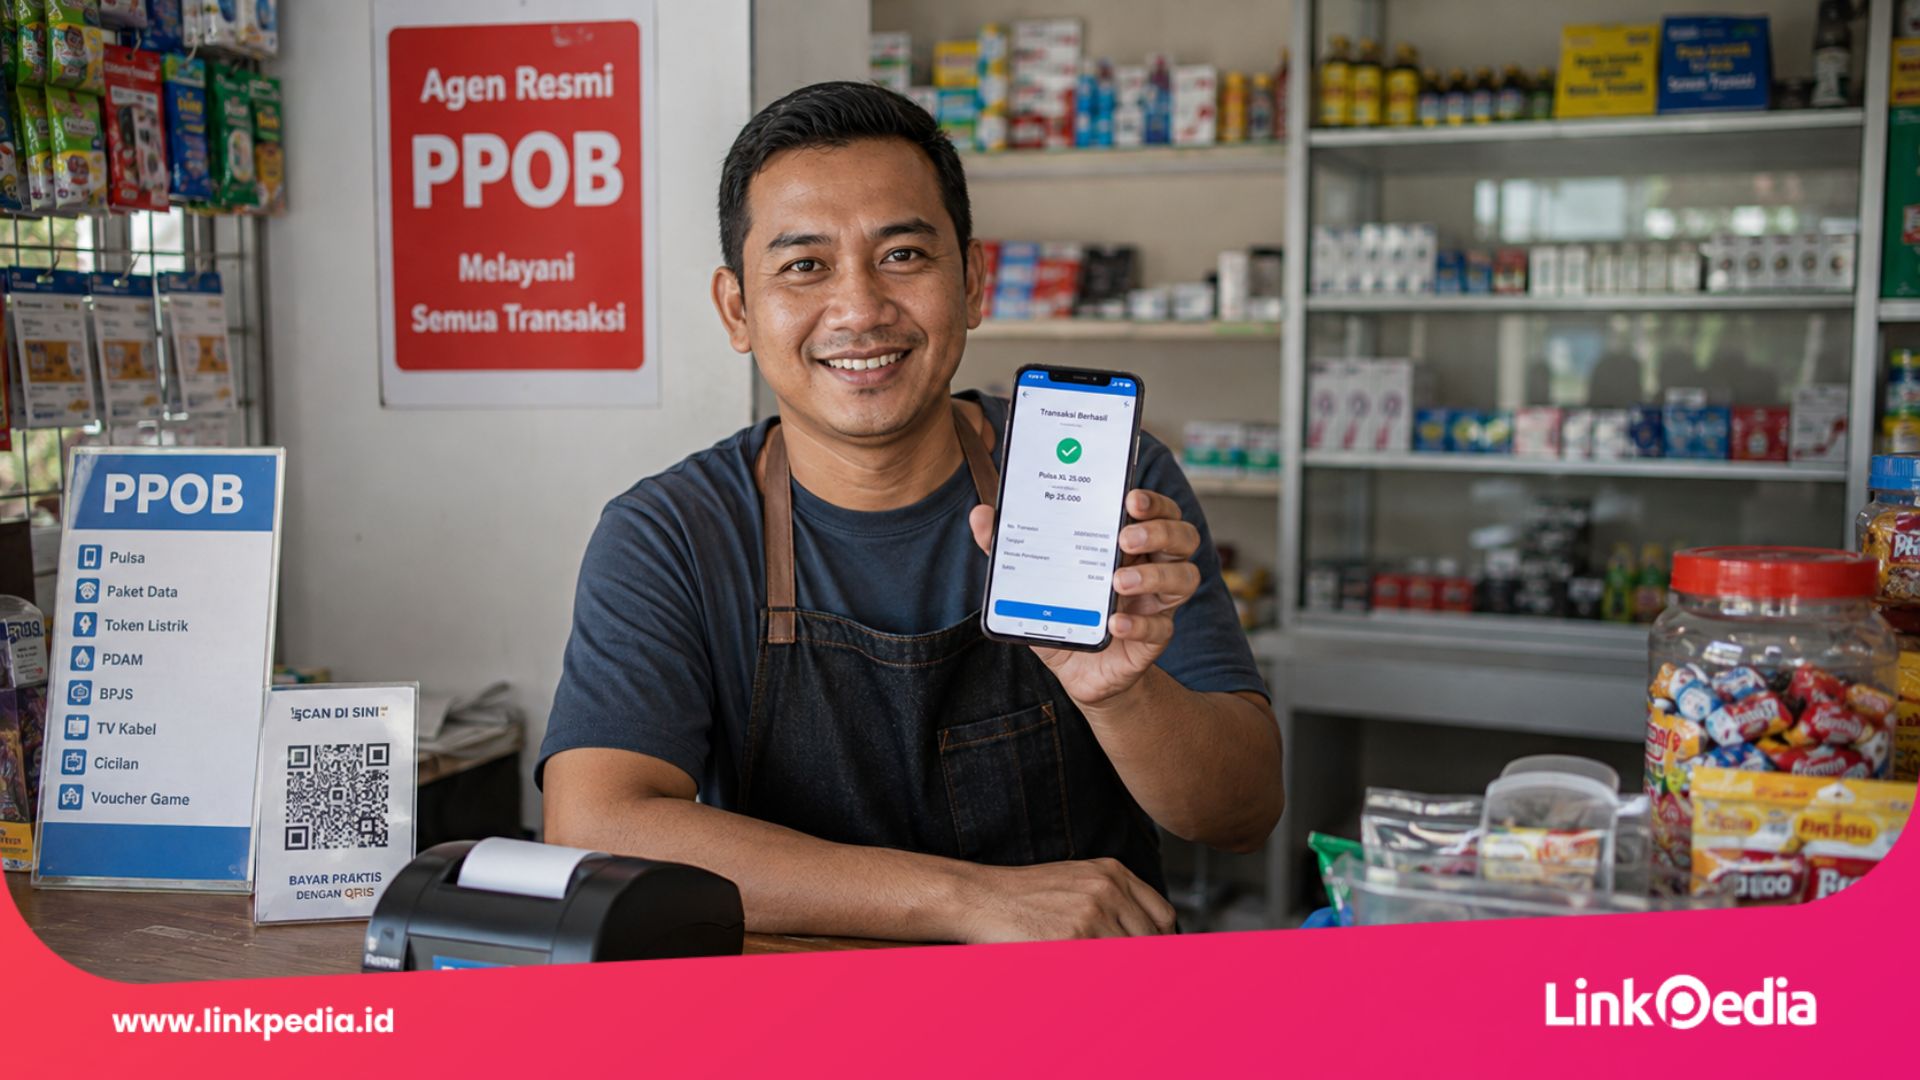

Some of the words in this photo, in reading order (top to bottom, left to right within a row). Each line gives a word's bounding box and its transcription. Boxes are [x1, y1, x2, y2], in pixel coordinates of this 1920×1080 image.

[420, 67, 506, 111] Agen
[515, 63, 614, 100] Resmi
[412, 130, 624, 208] PPOB
[458, 251, 575, 288] Melayani
[411, 304, 498, 333] Semua
[503, 302, 626, 333] Transaksi
[1040, 408, 1076, 419] Transaksi
[1077, 412, 1108, 422] Berhasil
[103, 473, 244, 514] PPOB
[1044, 491, 1055, 500] Rp
[1056, 493, 1082, 503] 25.000
[110, 551, 145, 564] Pulsa
[107, 585, 144, 598] Paket
[147, 585, 178, 598] Data
[105, 619, 144, 632] Token
[148, 620, 188, 632] Listrik
[102, 653, 143, 666] PDAM
[100, 688, 133, 700] BPJS
[334, 708, 348, 718] DI
[352, 706, 379, 718] SINI
[97, 722, 116, 735] TV
[119, 722, 156, 735] Kabel
[94, 757, 139, 770] Cicilan
[91, 791, 147, 805] Voucher
[150, 792, 190, 805] Game
[289, 874, 329, 886] BAYAR
[332, 872, 382, 884] PRAKTIS
[296, 889, 342, 900] DENGAN
[344, 887, 375, 899] QRIS
